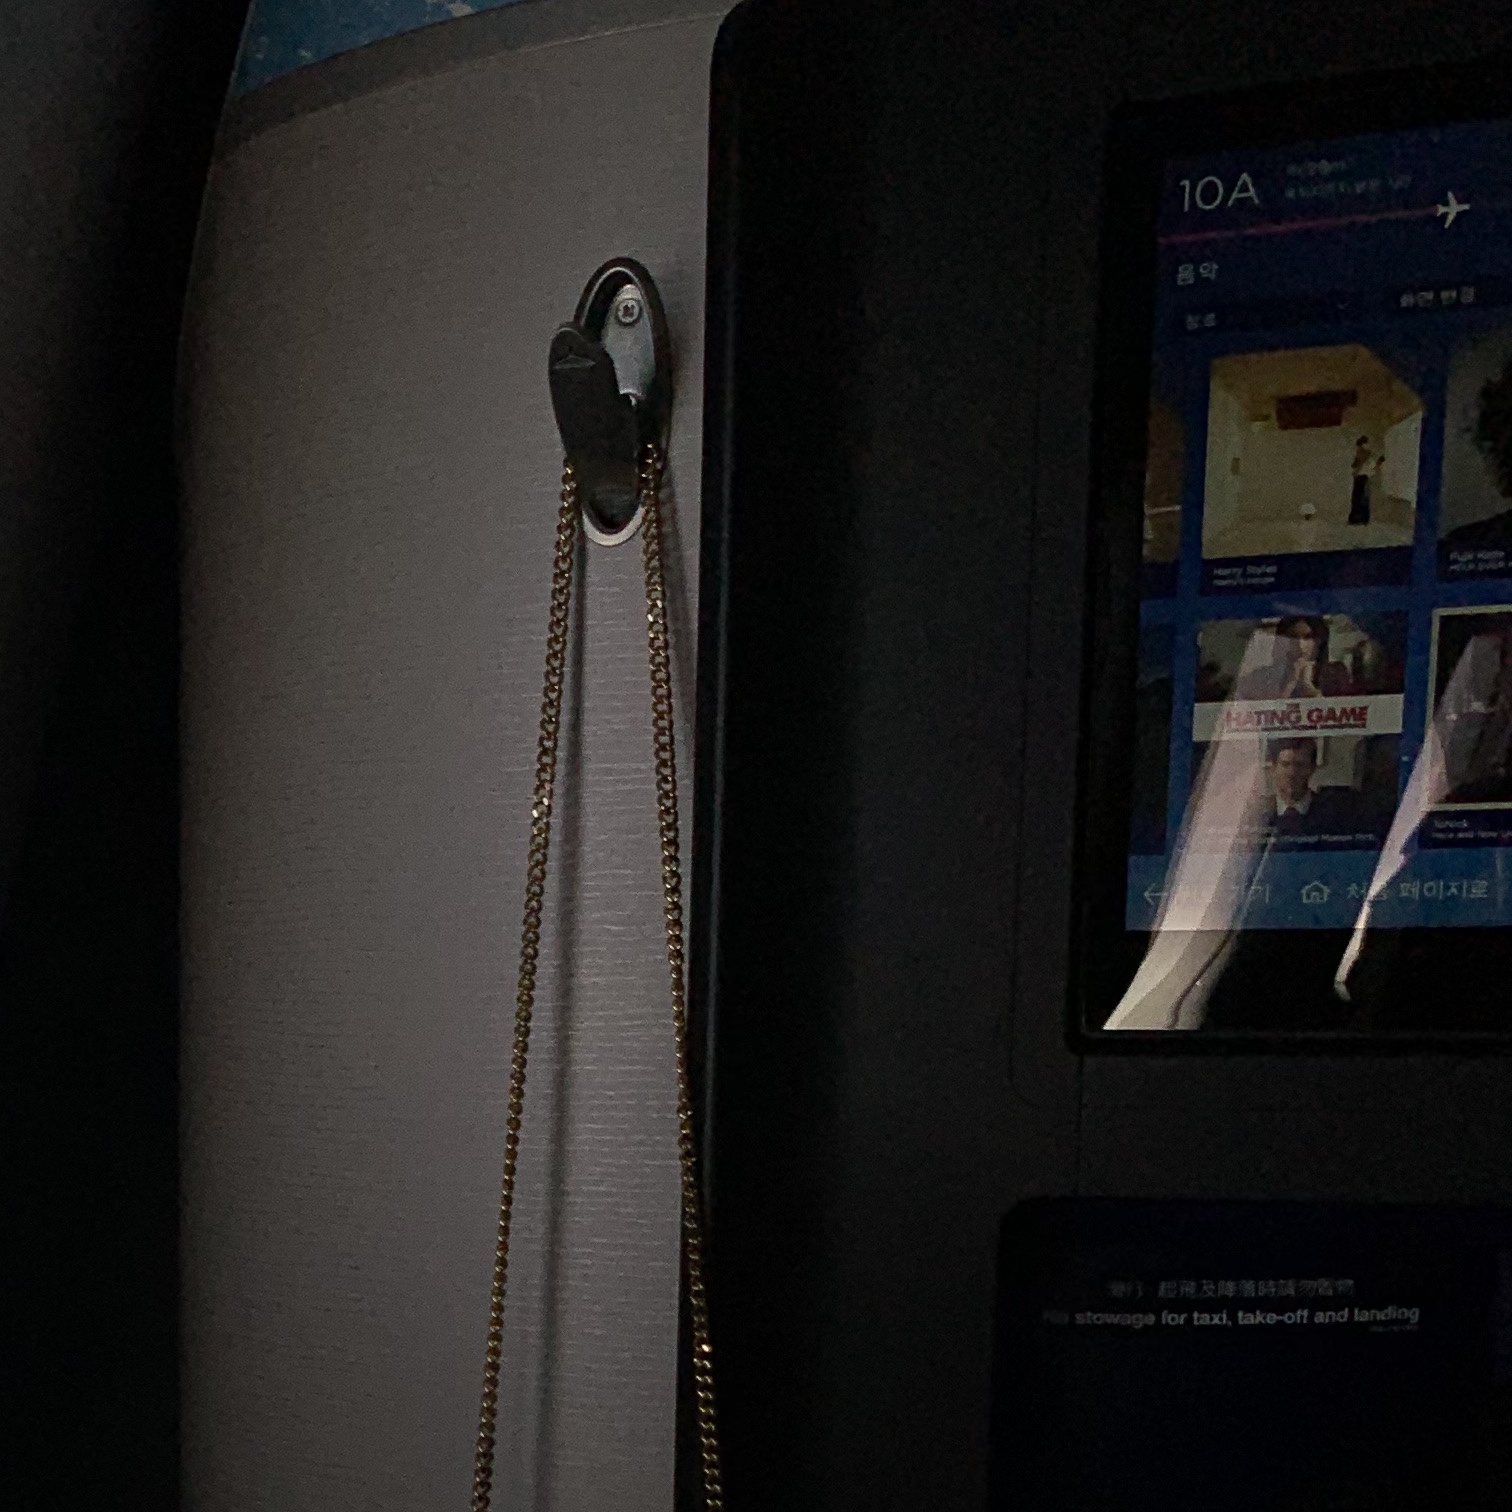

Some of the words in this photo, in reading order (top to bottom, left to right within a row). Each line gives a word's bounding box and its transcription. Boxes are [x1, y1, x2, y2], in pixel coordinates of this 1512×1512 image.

[1179, 172, 1260, 212] 10A
[1226, 709, 1302, 728] HATING
[1306, 705, 1369, 723] GAME
[1399, 879, 1489, 901] 페이지로
[1074, 1310, 1156, 1330] stowage
[1160, 1309, 1188, 1326] for
[1192, 1309, 1233, 1328] taxi,
[1237, 1308, 1309, 1325] take-off
[1313, 1307, 1349, 1324] and
[1353, 1305, 1420, 1325] landing
